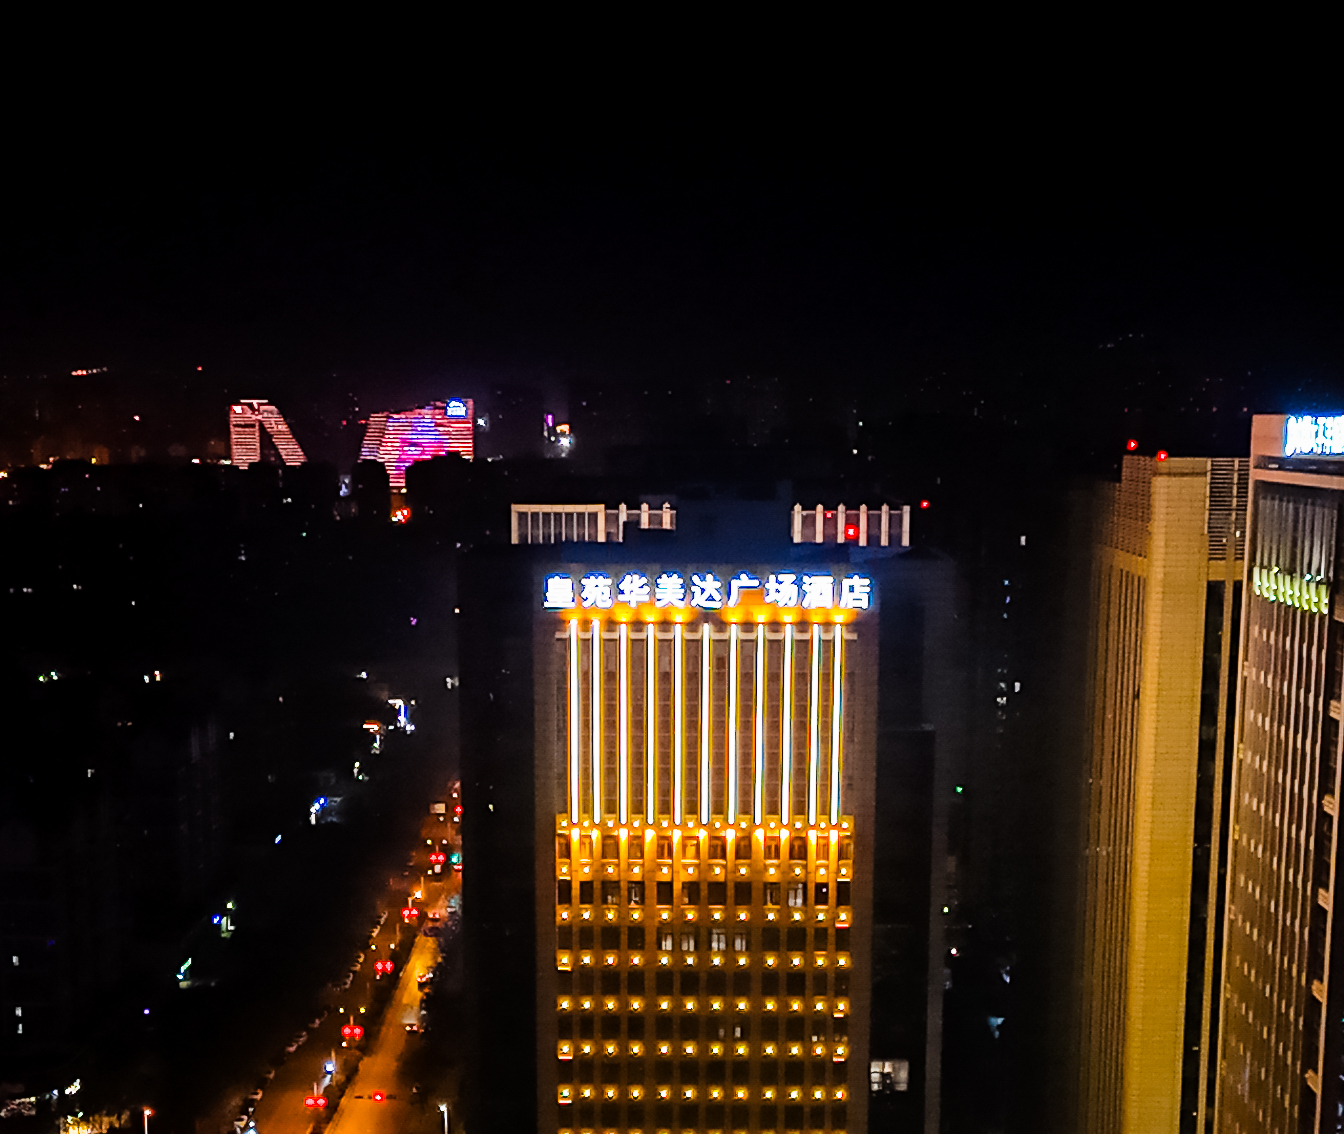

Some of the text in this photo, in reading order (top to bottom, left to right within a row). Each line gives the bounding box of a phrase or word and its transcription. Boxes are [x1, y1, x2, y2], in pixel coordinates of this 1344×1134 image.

[543, 573, 871, 609] 皇苑华美达广场酒店
